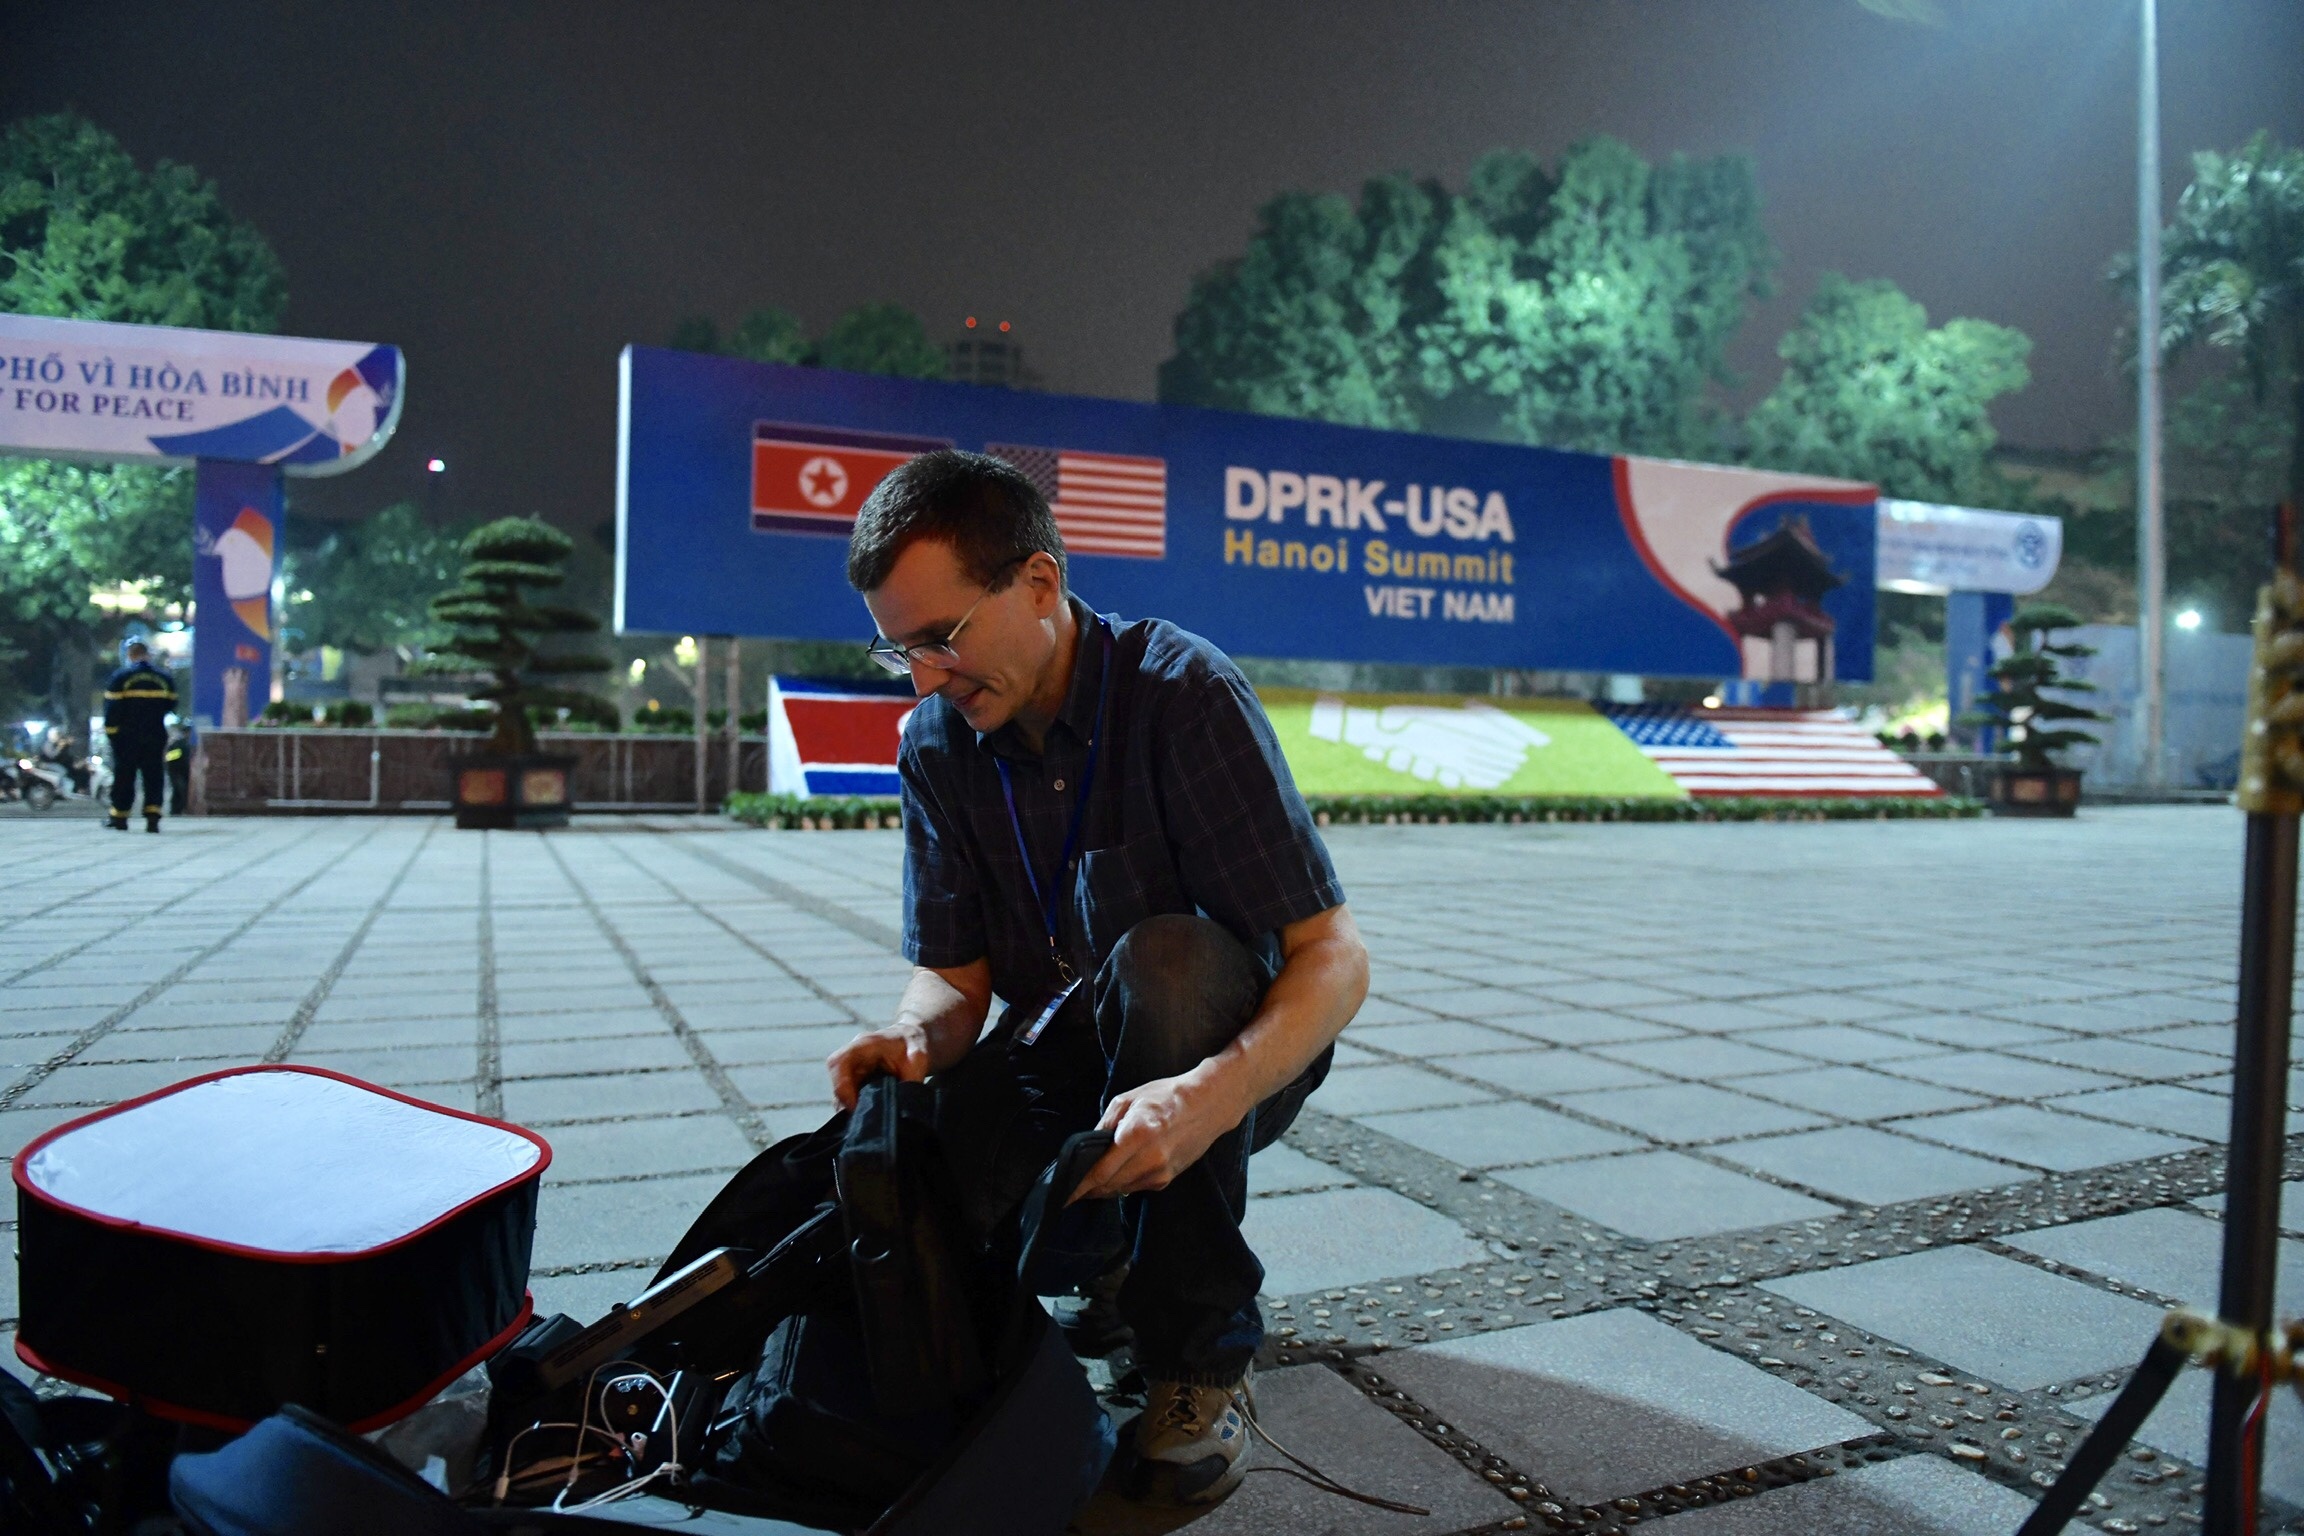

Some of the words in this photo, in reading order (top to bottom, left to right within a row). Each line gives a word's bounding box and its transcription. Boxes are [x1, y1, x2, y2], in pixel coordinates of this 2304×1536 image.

[79, 356, 116, 388] VÌ
[129, 361, 207, 396] HÒA
[221, 369, 309, 402] BÌNH
[15, 388, 80, 414] FOR
[92, 394, 194, 421] PEACE
[1225, 466, 1515, 543] DPRK-USA
[1224, 528, 1347, 573] Hanoi
[1364, 539, 1515, 584] Summit
[1364, 585, 1436, 619] VIET
[1443, 591, 1515, 623] NAM
